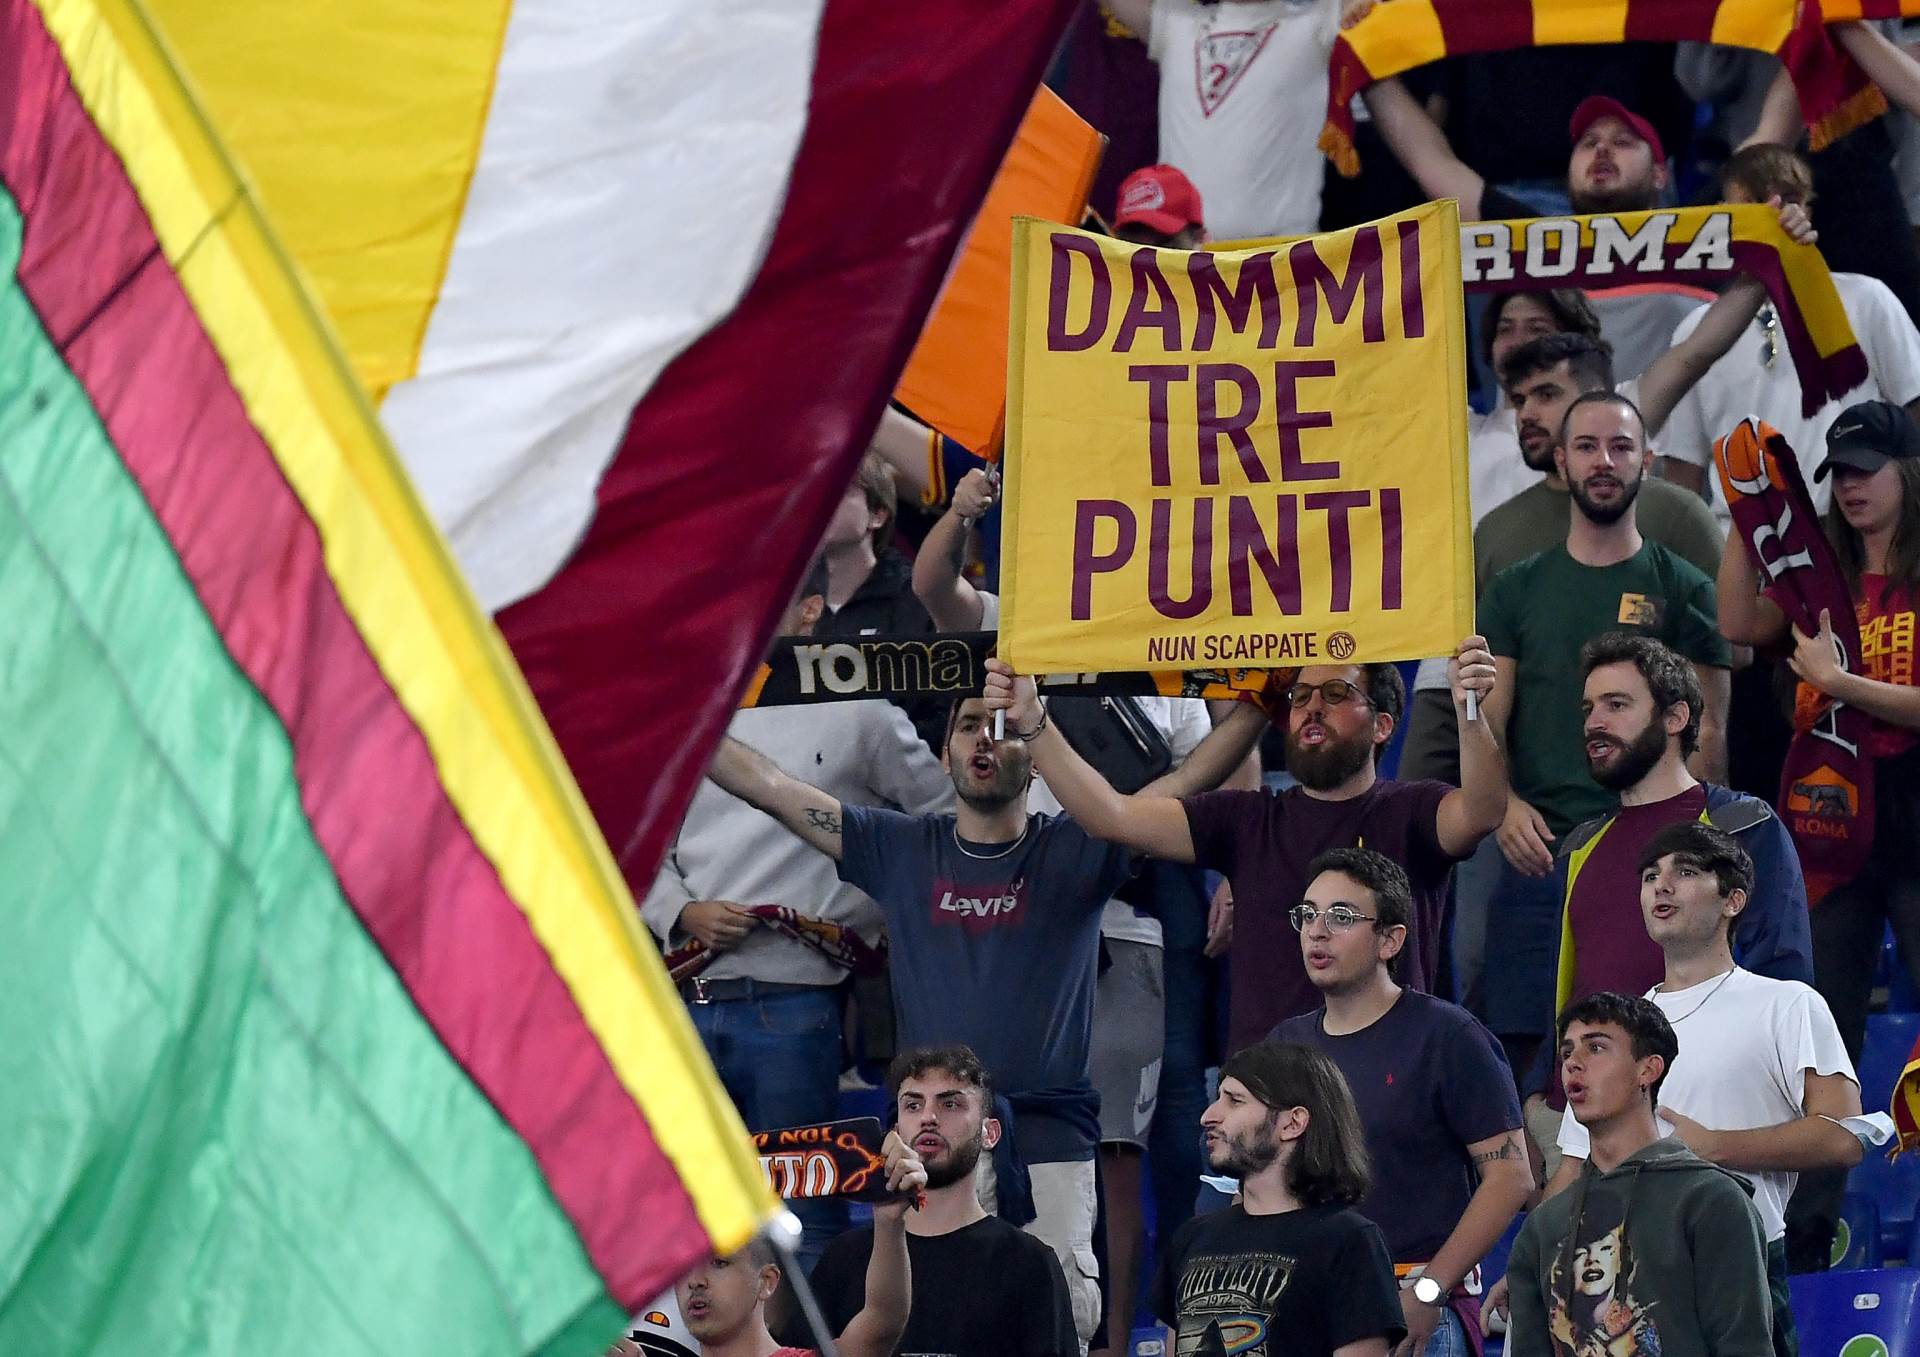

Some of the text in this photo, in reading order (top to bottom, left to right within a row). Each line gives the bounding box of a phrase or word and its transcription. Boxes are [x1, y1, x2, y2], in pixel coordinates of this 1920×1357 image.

[1460, 211, 1735, 282] ROMA
[1048, 220, 1424, 352] DAMMI
[1128, 360, 1341, 487] TRE
[1070, 488, 1403, 621] PUNTI
[793, 639, 974, 694] roma
[1148, 636, 1196, 662] NUN
[1204, 632, 1318, 661] SCAPPATE
[1794, 818, 1849, 839] ROMA
